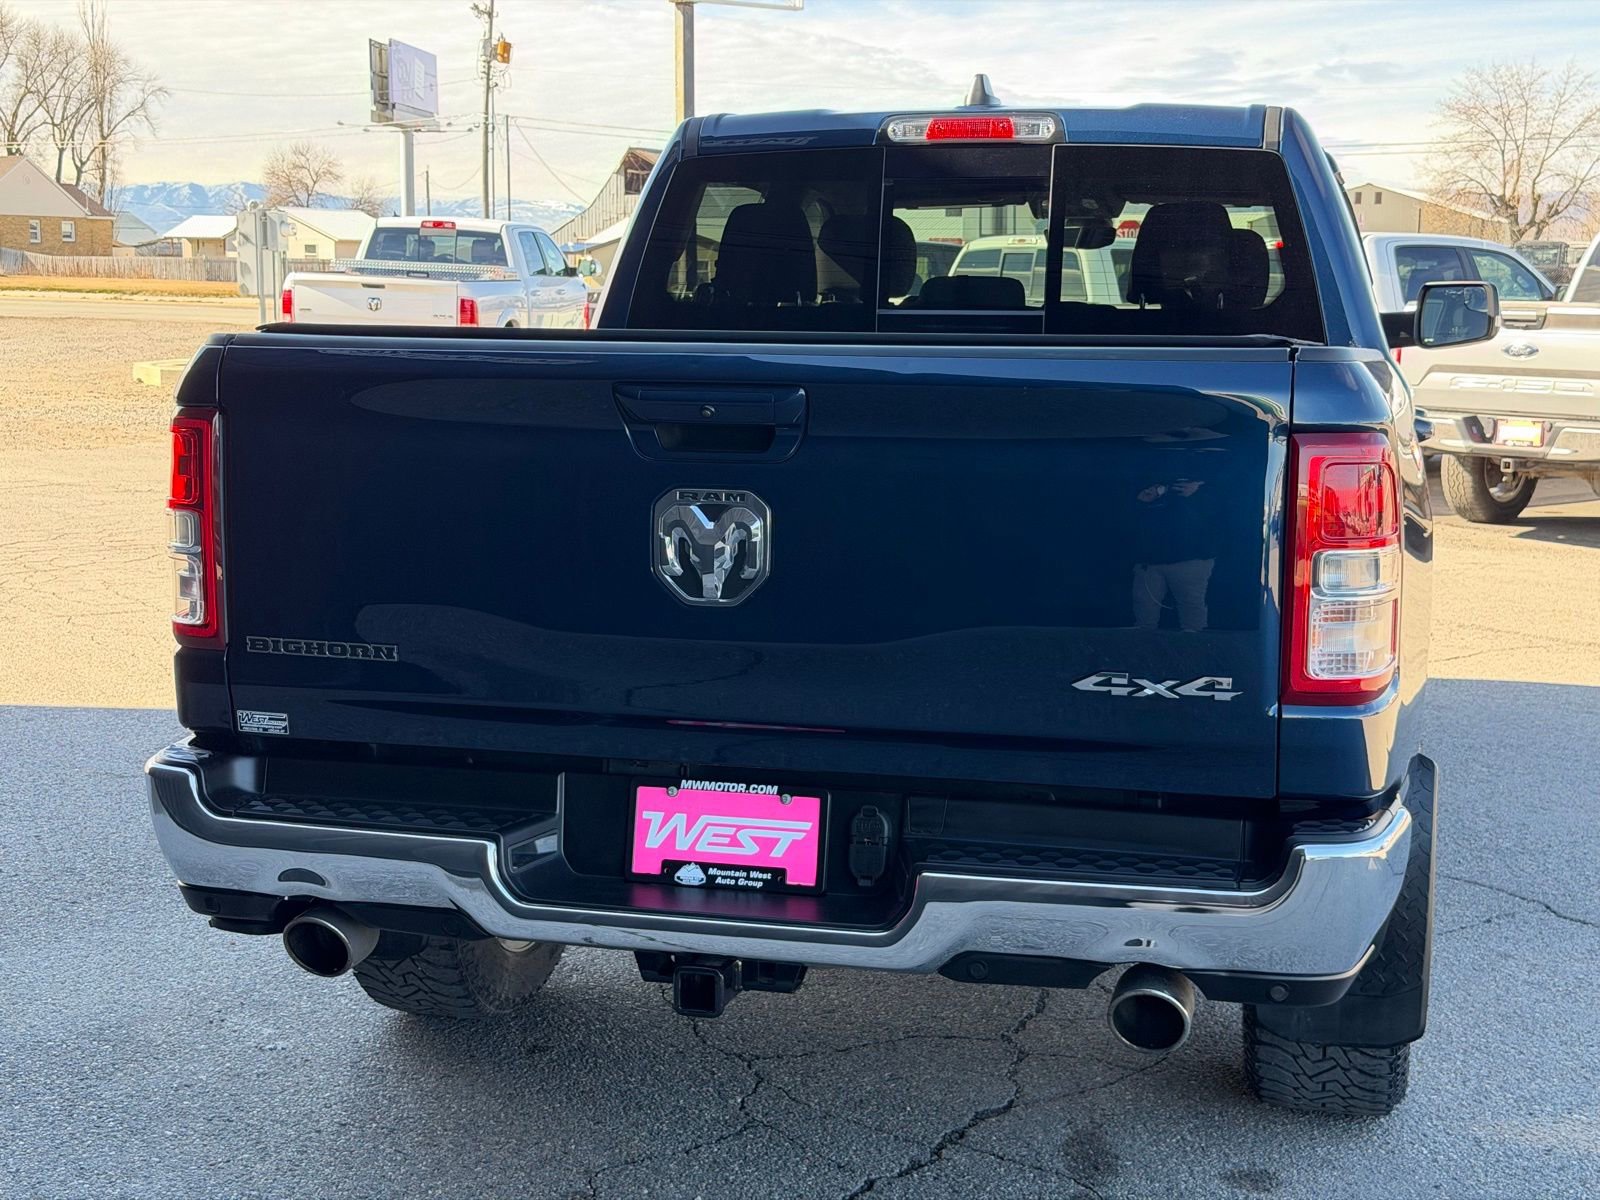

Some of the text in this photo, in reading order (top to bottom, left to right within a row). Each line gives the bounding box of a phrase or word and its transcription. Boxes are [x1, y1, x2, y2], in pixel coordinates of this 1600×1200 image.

[1116, 228, 1137, 238] STO
[676, 491, 746, 502] RAM
[246, 635, 398, 661] BIGHORN
[680, 779, 779, 795] MWMOTOR.COM
[642, 810, 813, 858] WEST
[708, 867, 772, 880] Mountain West
[715, 876, 764, 889] Auto Group
